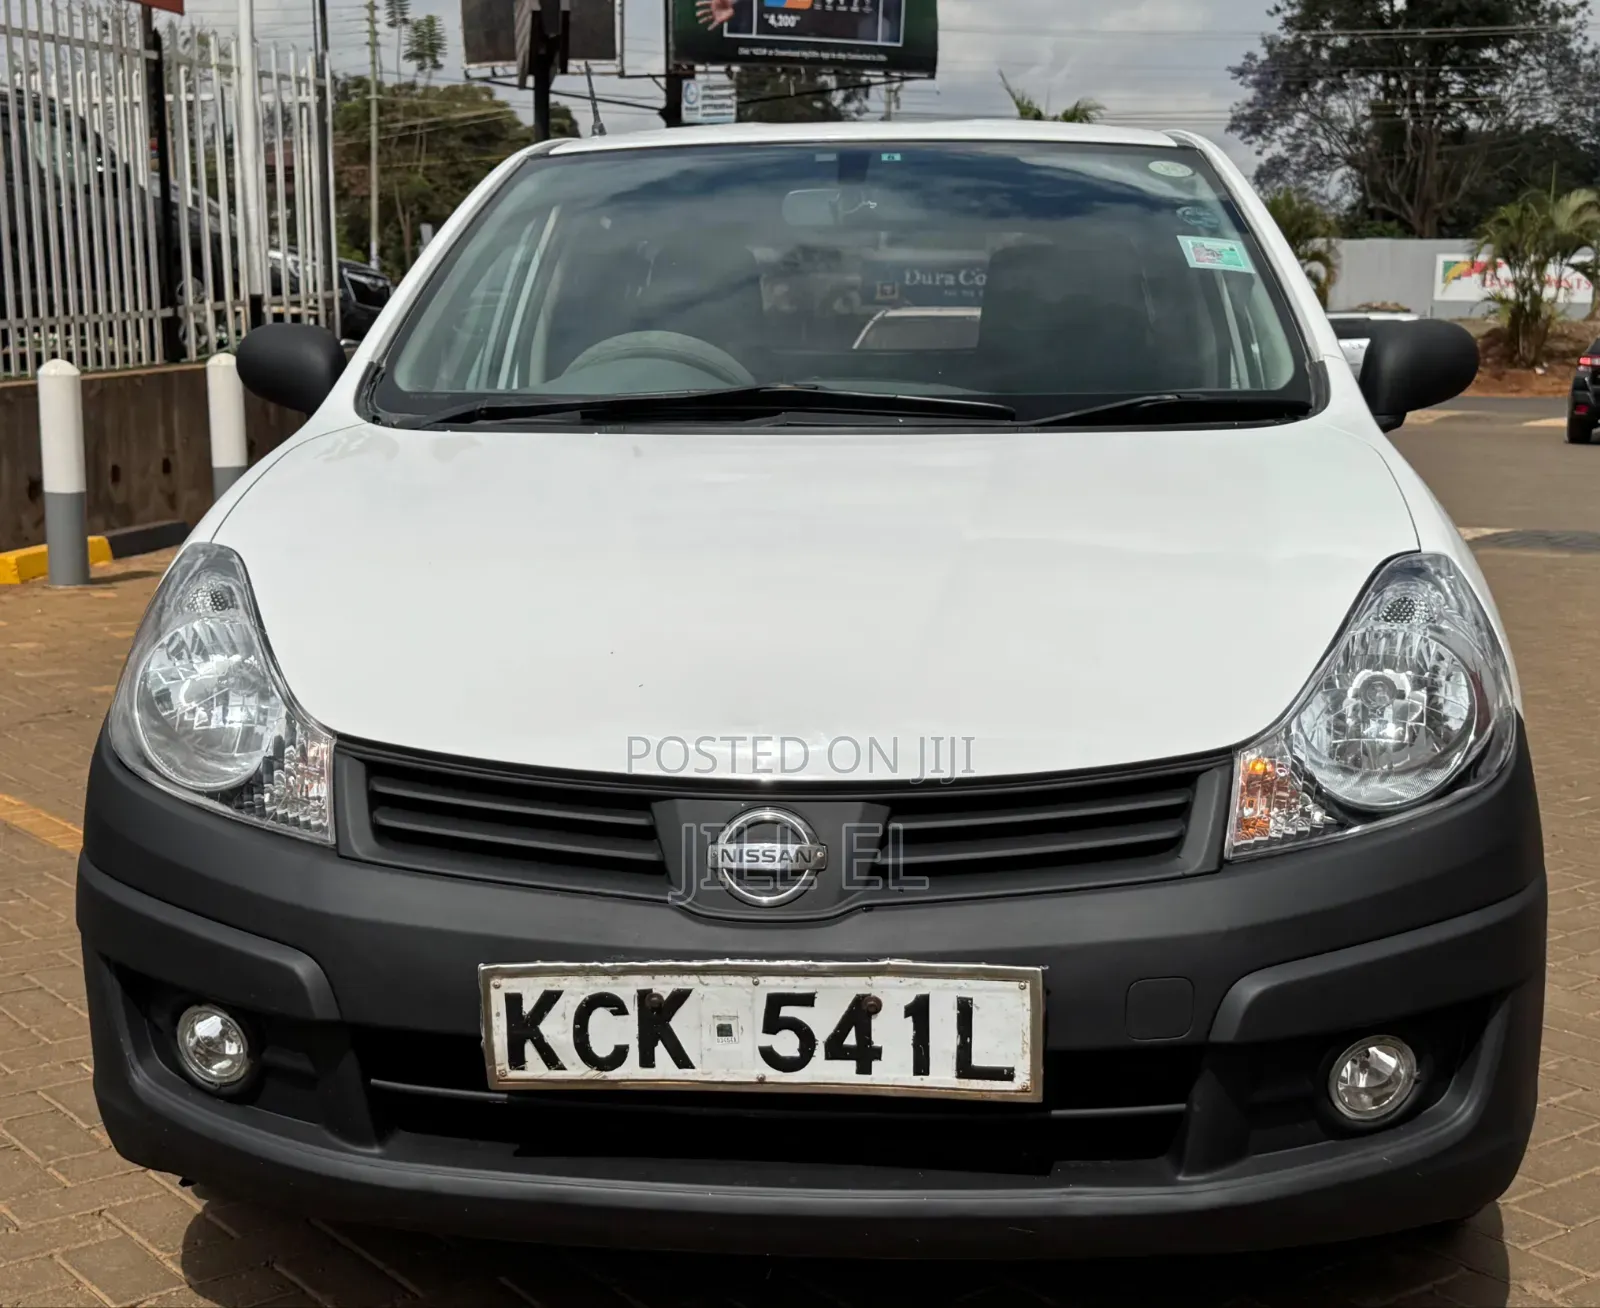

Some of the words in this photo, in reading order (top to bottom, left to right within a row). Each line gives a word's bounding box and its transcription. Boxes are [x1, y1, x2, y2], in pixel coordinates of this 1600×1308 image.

[958, 269, 988, 286] Co
[720, 848, 813, 863] NISSAN
[504, 988, 696, 1072] KCK
[757, 991, 1016, 1082] 541L
